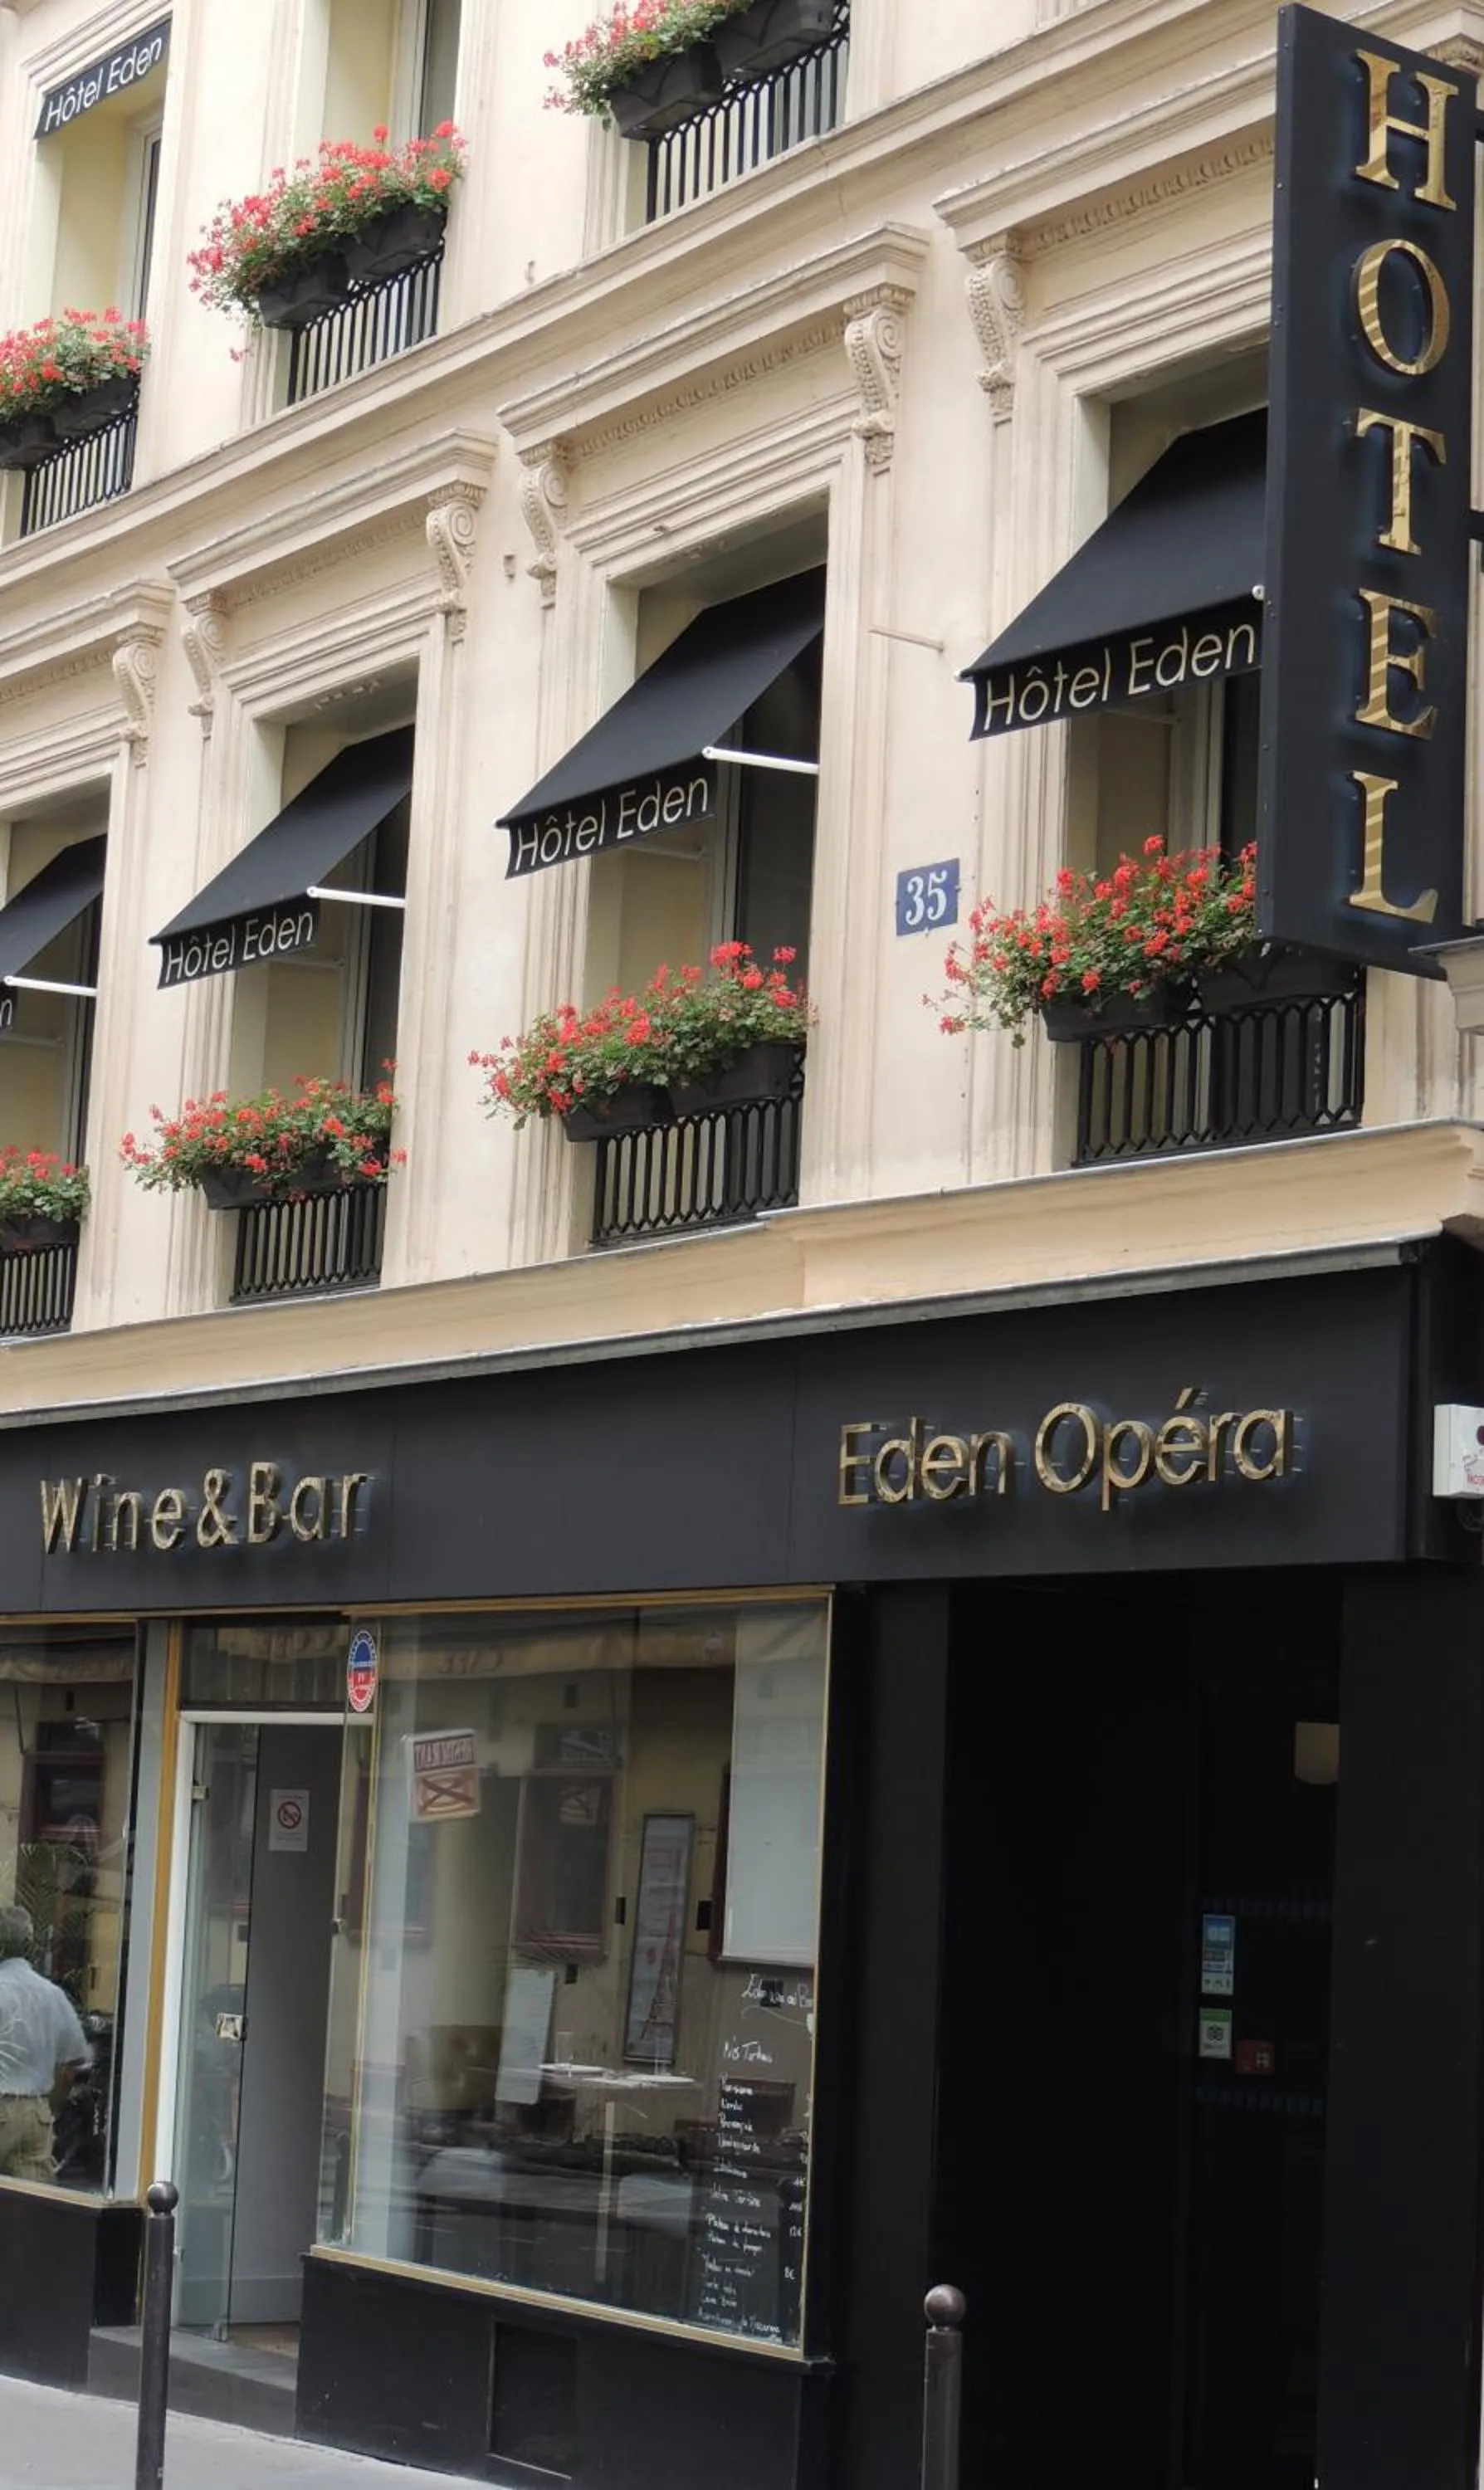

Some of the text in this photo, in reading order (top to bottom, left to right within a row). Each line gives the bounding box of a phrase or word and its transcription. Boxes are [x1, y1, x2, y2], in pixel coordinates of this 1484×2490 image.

[44, 36, 162, 132] Hôtel Eden
[1350, 48, 1459, 925] HOTEL
[984, 624, 1255, 730] Hôtel Eden
[515, 778, 708, 871] Hôtel Eden
[906, 870, 947, 925] 35
[165, 910, 313, 983] Hôtel Eden
[838, 1387, 1287, 1511] Eden Opéra
